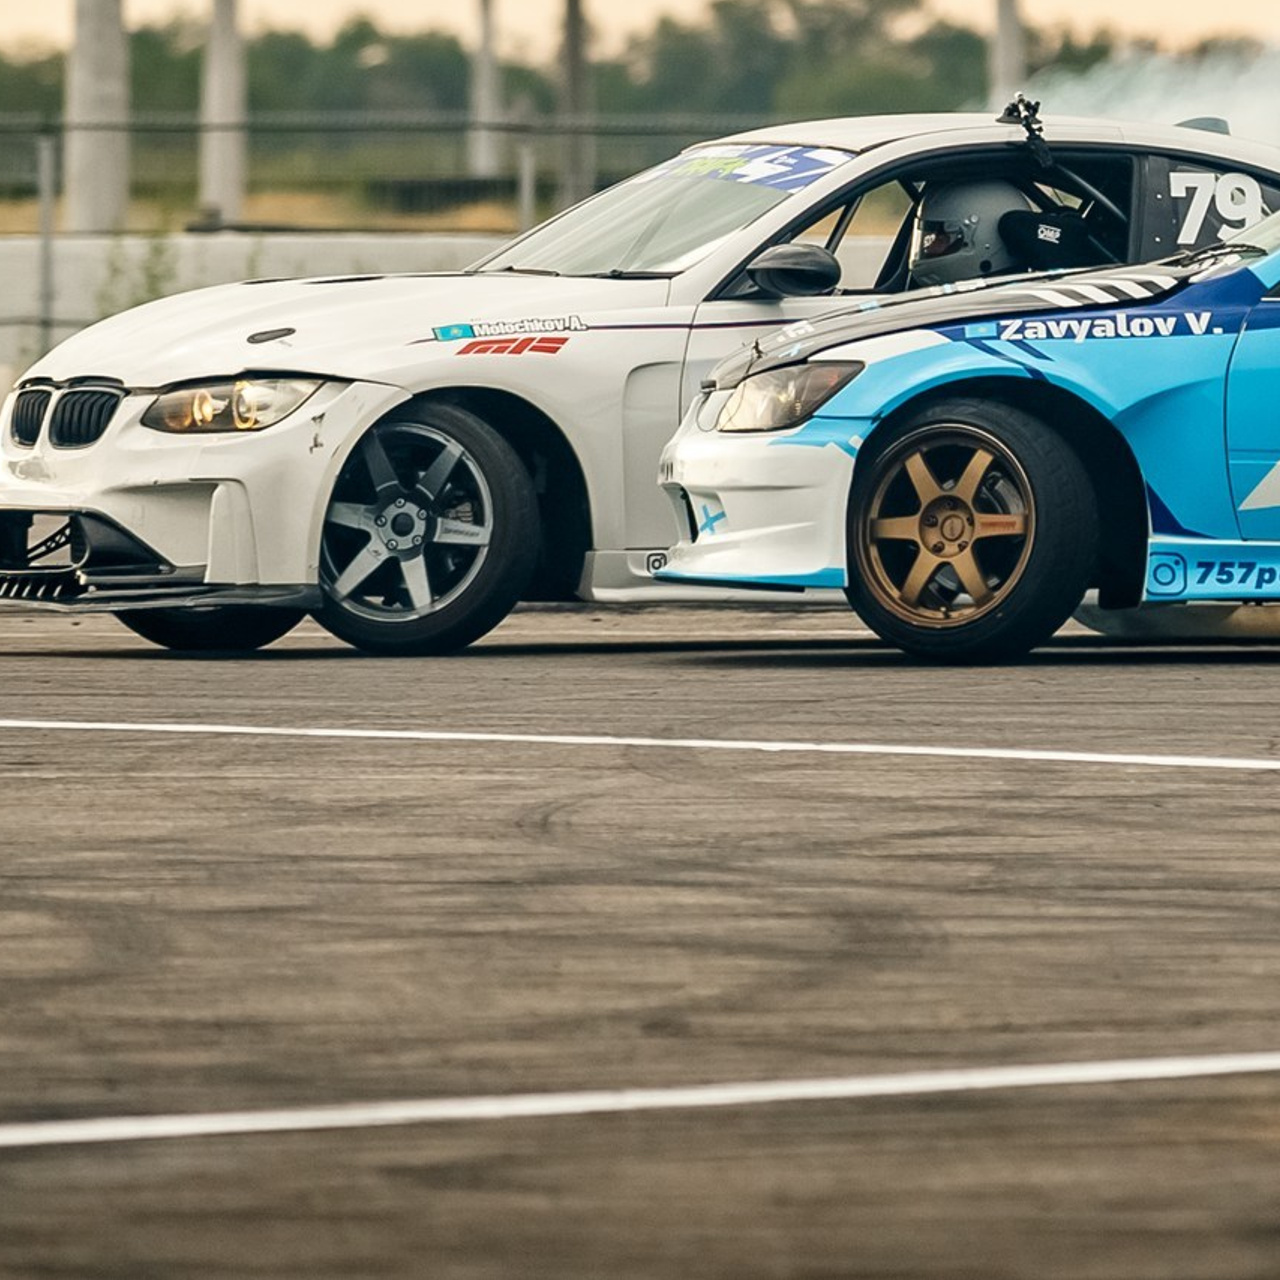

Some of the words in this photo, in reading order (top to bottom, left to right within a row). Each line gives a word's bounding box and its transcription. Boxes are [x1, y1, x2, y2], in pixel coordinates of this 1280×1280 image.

[1169, 172, 1263, 244] 79
[473, 318, 566, 337] Molochkov
[568, 314, 588, 331] A.
[1000, 312, 1178, 343] Zavyalov
[1183, 312, 1224, 335] V.
